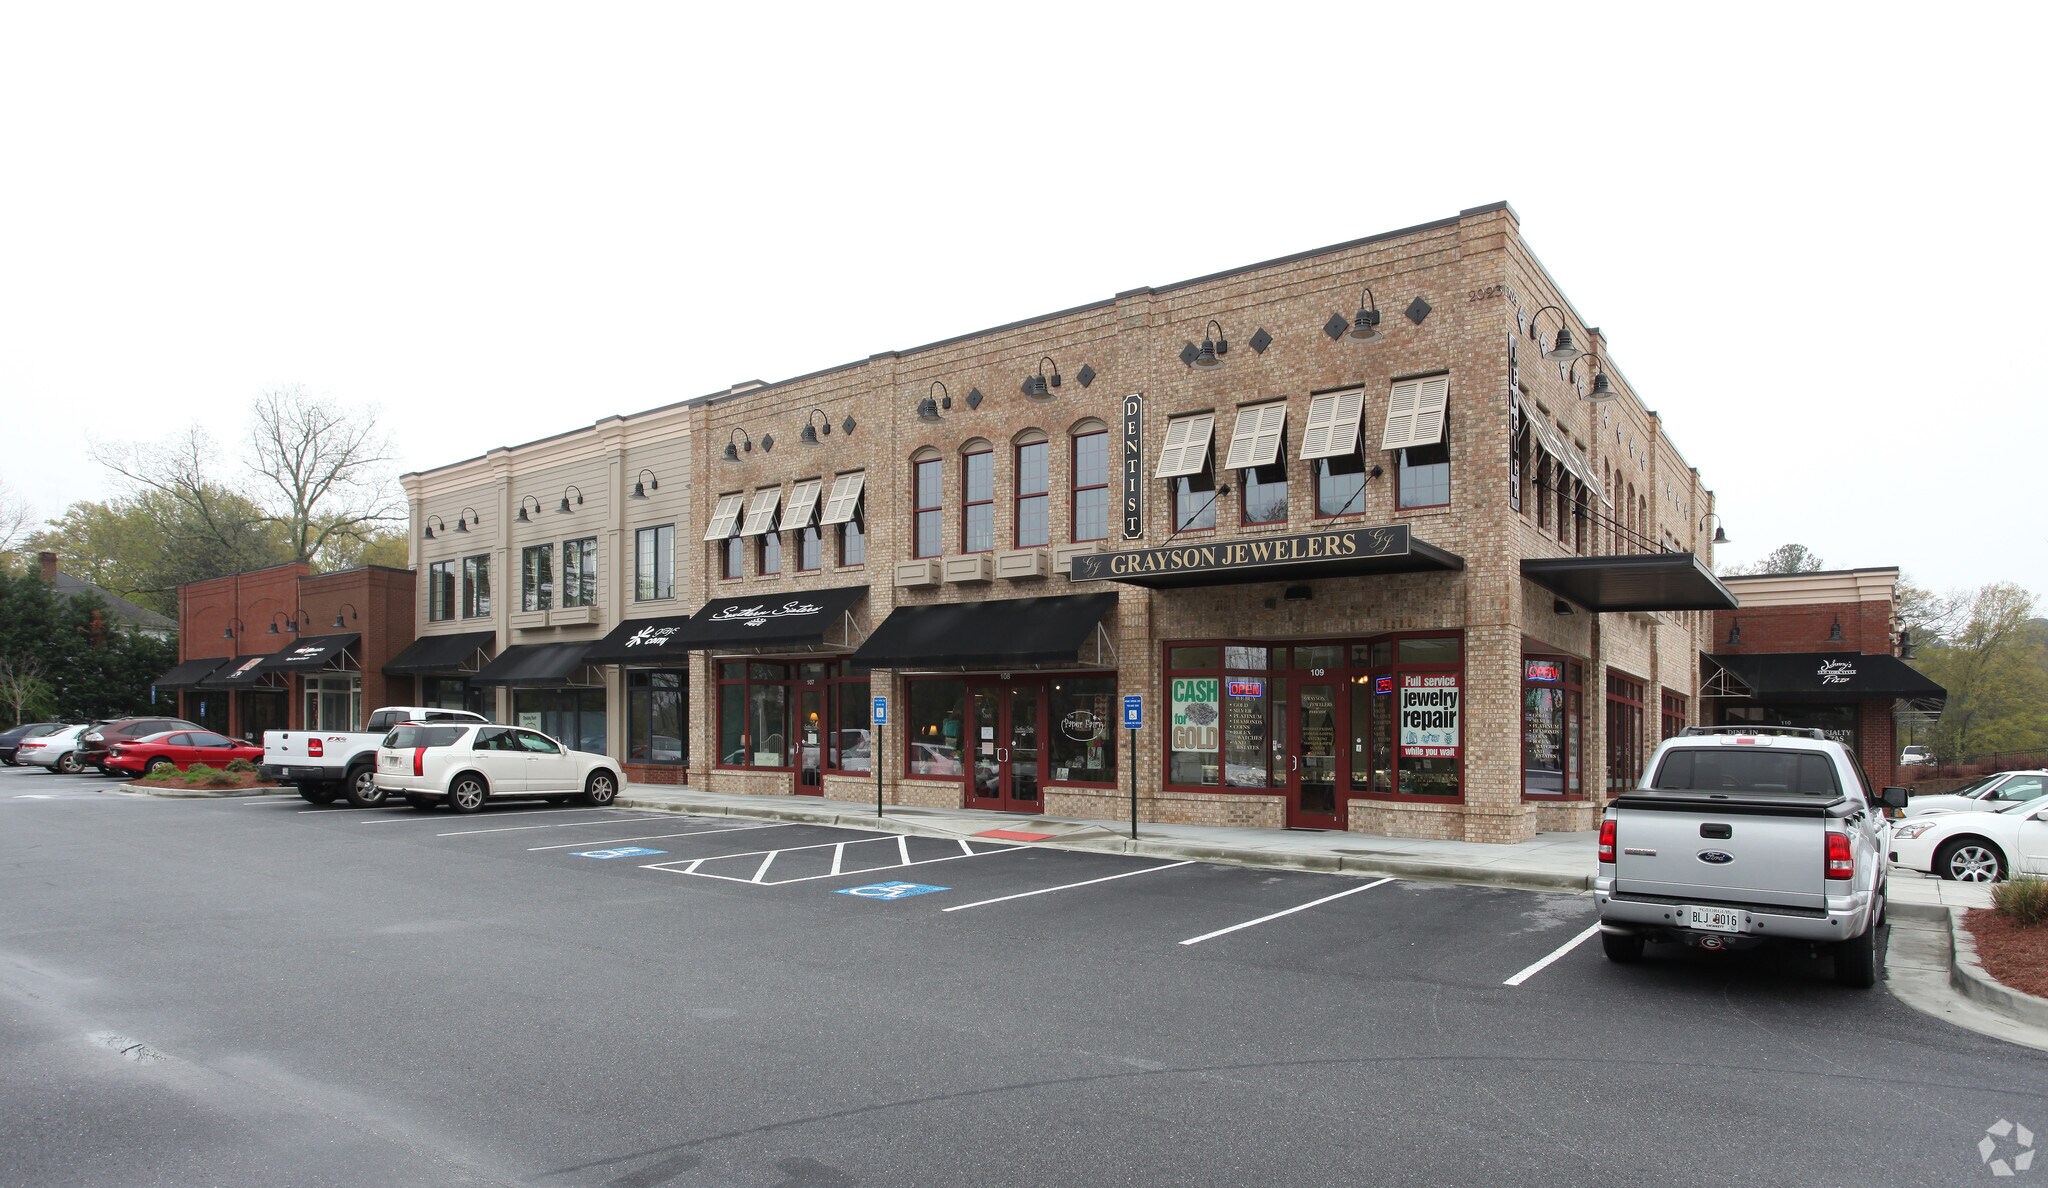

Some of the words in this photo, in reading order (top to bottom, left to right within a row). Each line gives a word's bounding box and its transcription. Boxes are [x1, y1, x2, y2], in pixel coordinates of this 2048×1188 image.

[1468, 285, 1502, 302] 2023
[1126, 401, 1138, 531] DENTIST
[1110, 547, 1216, 574] GRAYSON
[1222, 533, 1356, 565] JEWELERS
[1310, 668, 1325, 677] 109
[1528, 666, 1559, 678] OPEN
[1405, 675, 1421, 687] Full
[1424, 675, 1456, 687] service
[1173, 680, 1218, 703] CASH
[1231, 683, 1260, 695] OPEN
[1403, 688, 1458, 709] jewelry
[1063, 718, 1083, 730] Paper
[1174, 712, 1188, 725] for
[1403, 706, 1457, 731] repair
[1173, 725, 1218, 750] GOLD
[1405, 747, 1424, 756] while
[1425, 748, 1438, 757] you
[1440, 748, 1455, 756] wait
[1704, 851, 1725, 861] Ford
[1692, 911, 1709, 924] BLJ
